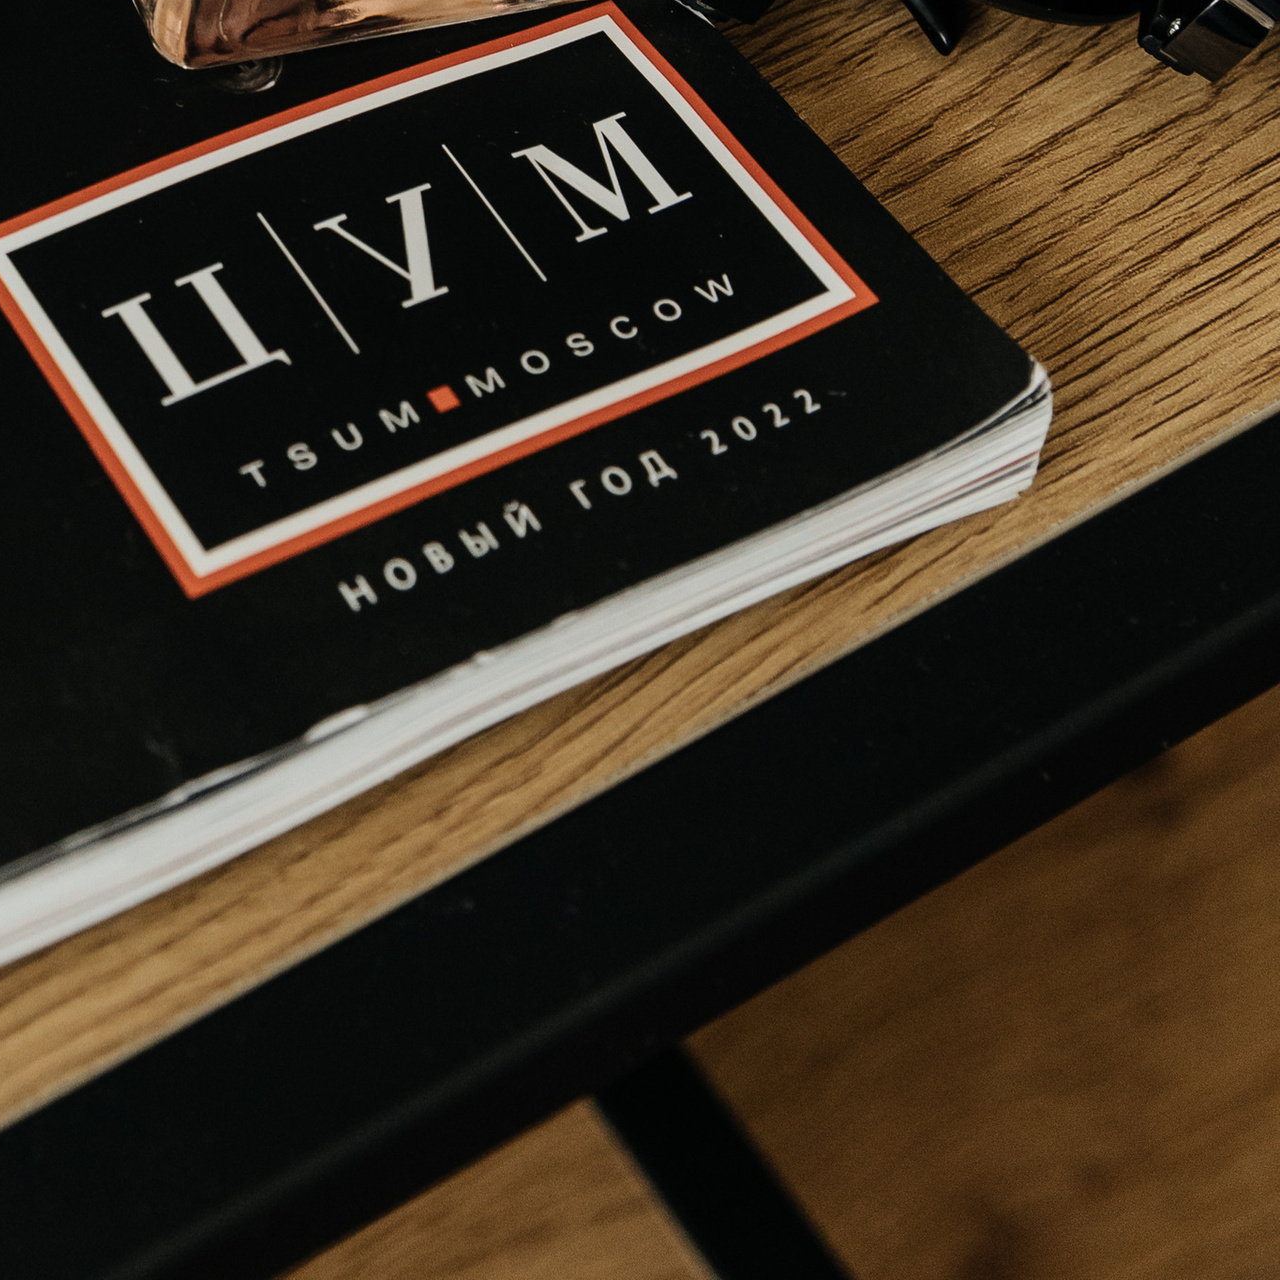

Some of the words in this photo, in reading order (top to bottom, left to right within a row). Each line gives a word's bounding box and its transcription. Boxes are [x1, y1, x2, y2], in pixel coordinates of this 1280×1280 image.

[238, 399, 421, 489] TSUM
[464, 272, 735, 398] MOSCOW
[337, 499, 543, 613] НОВЫЙ
[569, 448, 678, 510] ГОД
[700, 388, 821, 456] 2022
